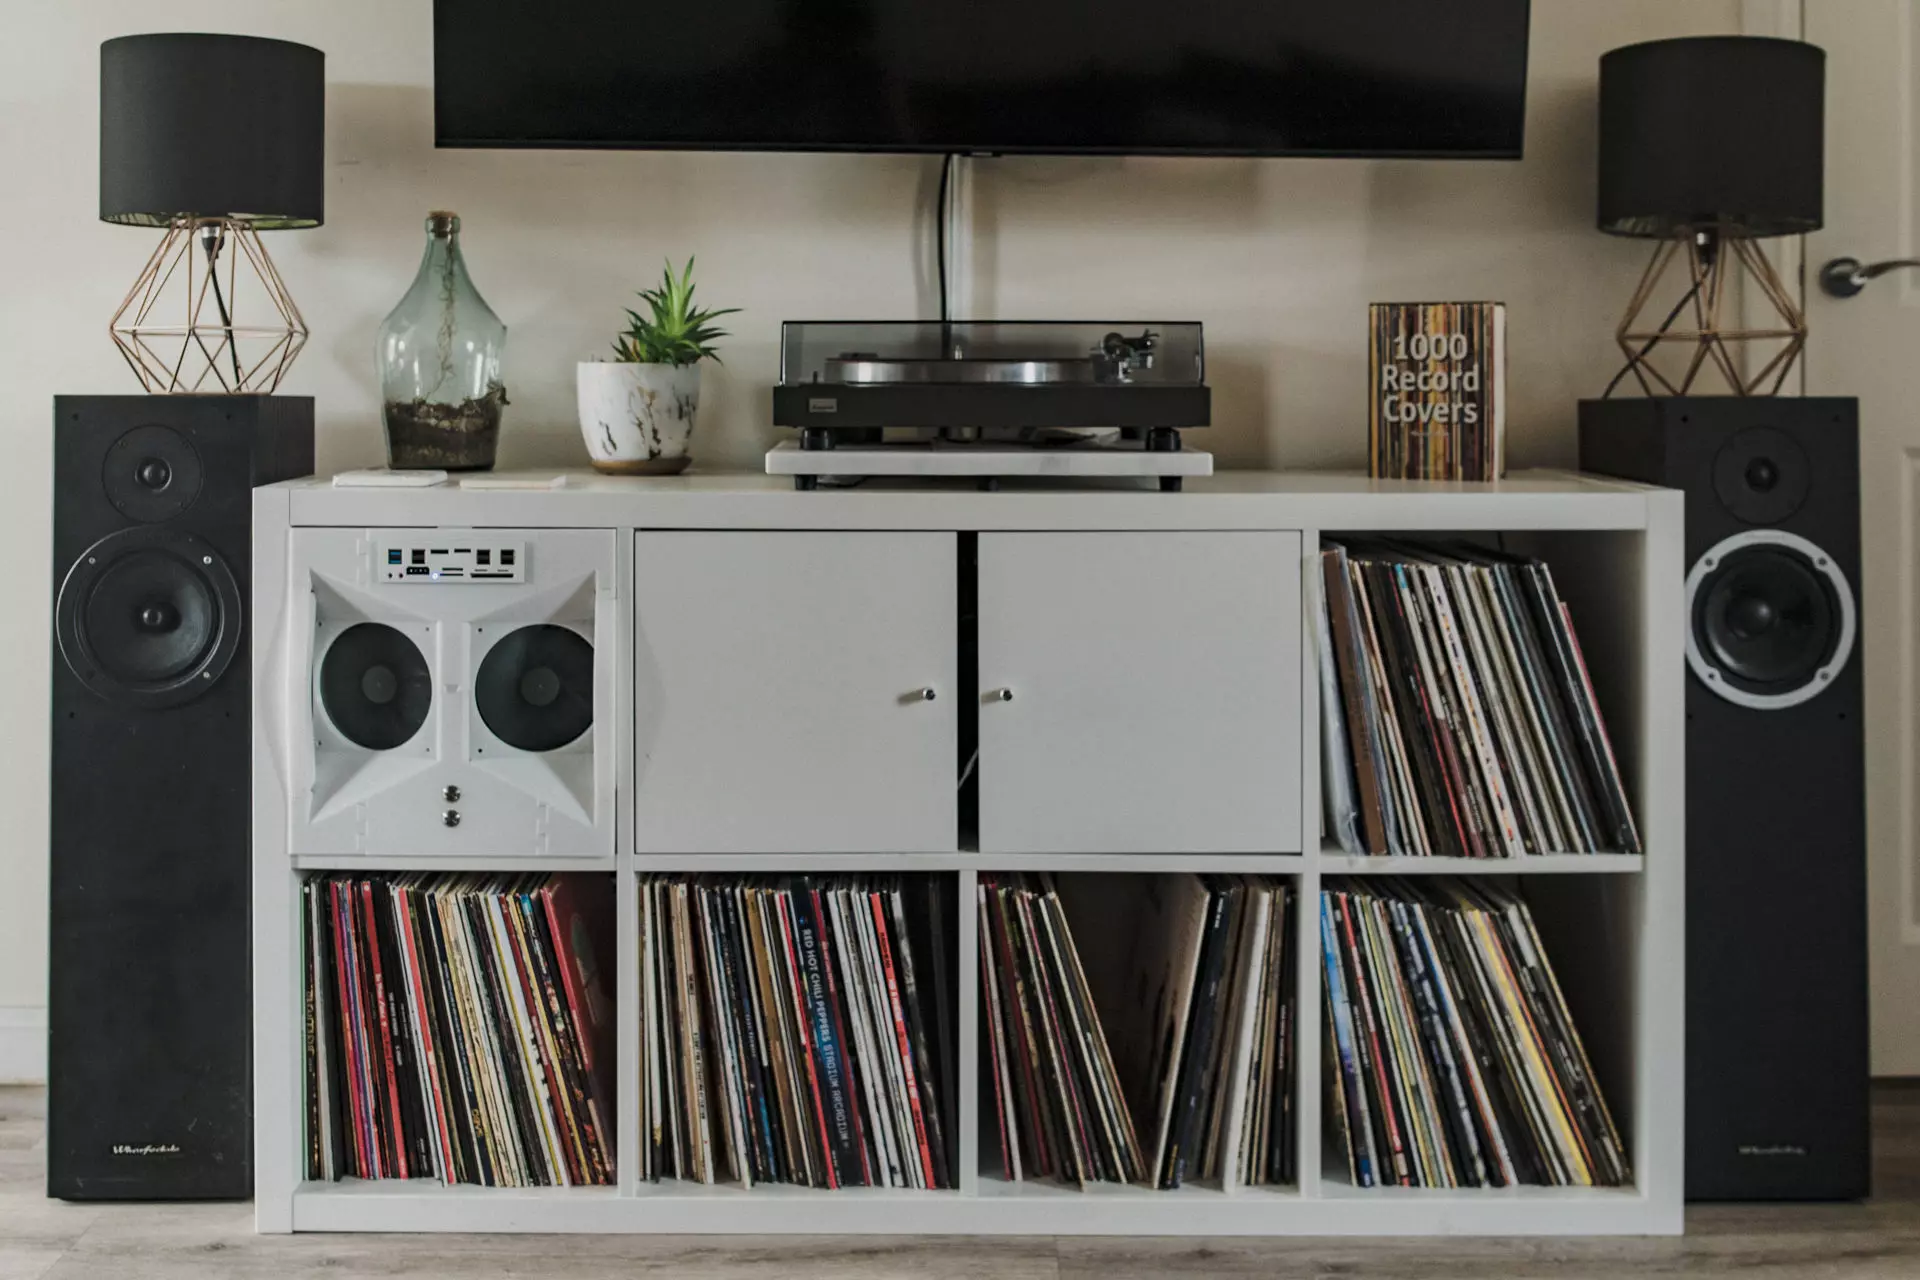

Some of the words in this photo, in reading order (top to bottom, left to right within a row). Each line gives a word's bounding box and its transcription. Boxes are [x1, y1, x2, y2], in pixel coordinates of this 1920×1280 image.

[1393, 333, 1468, 360] 1000
[1382, 363, 1479, 392] Record
[1383, 395, 1478, 423] Covers
[803, 928, 814, 948] RED
[806, 951, 818, 971] HOT
[811, 973, 823, 999] CHILI
[816, 1001, 831, 1042] PEPPERS
[823, 1044, 839, 1087] STADIUM
[832, 1089, 849, 1140] ARCADIUM
